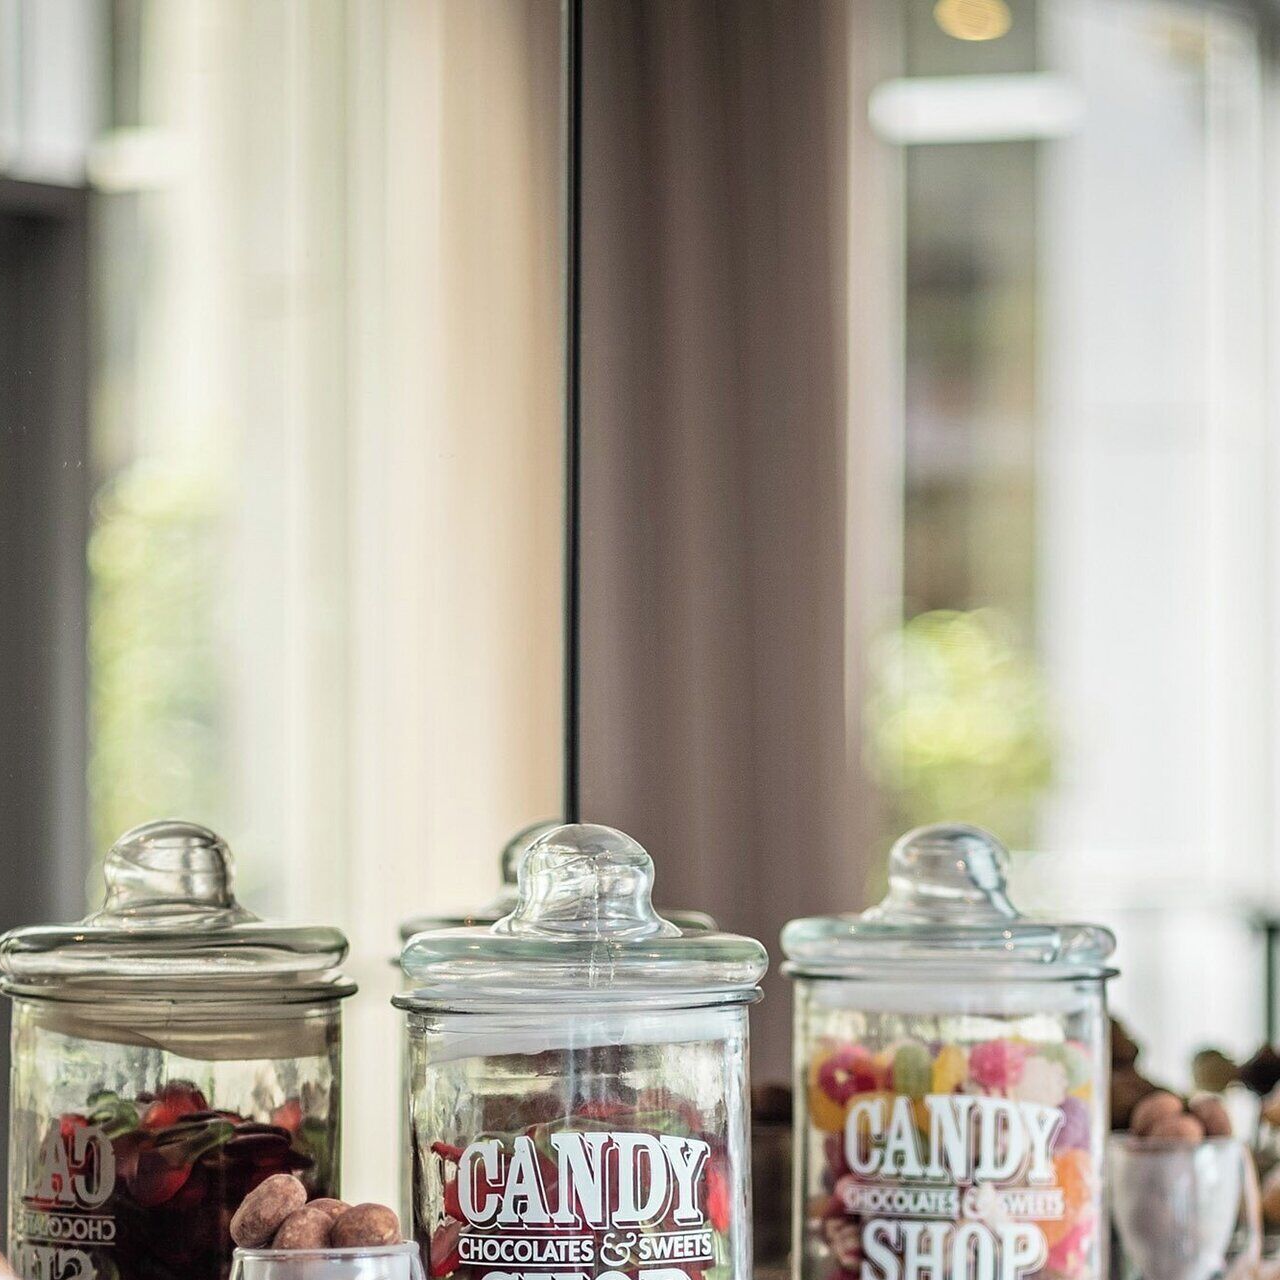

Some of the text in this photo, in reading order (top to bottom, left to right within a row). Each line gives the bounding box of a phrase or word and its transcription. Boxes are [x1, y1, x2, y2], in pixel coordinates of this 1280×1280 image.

[457, 1131, 711, 1231] CANDY
[845, 1094, 1066, 1186] CANDY
[457, 1231, 713, 1267] CHOCOLATES & SWEETS
